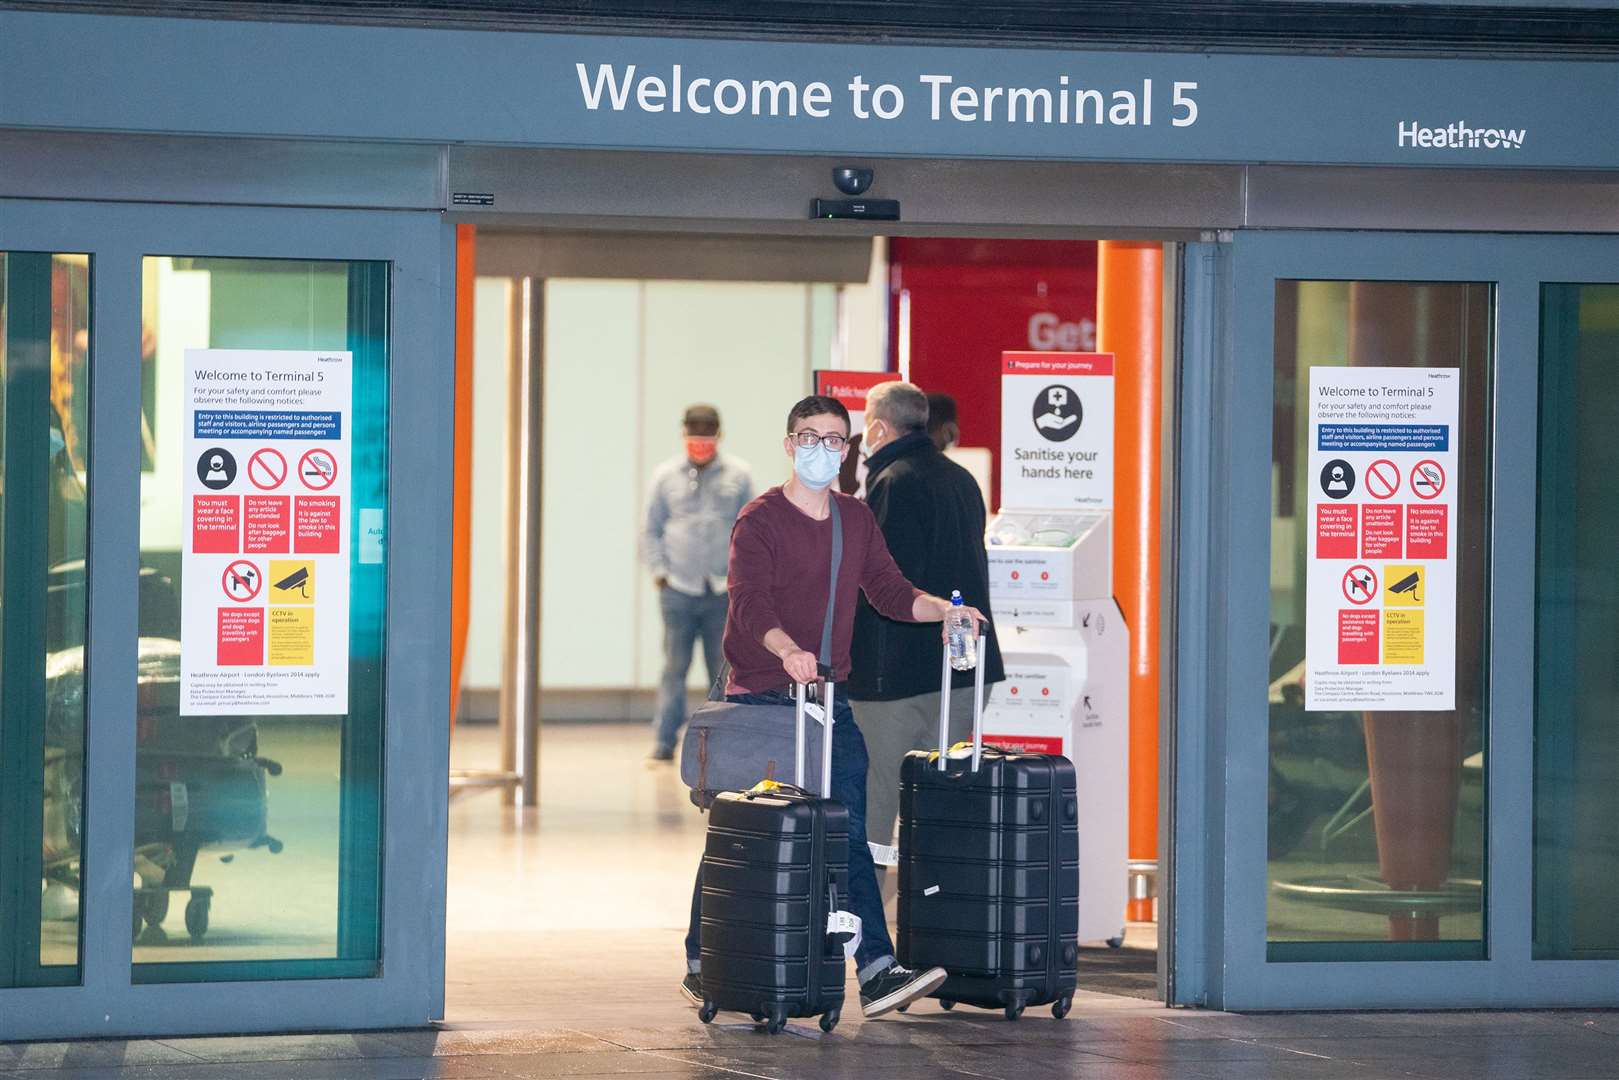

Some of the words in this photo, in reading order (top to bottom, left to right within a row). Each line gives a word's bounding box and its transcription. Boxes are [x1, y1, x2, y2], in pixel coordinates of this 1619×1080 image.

[575, 63, 832, 118] Welcome
[848, 75, 904, 119] to
[920, 74, 1151, 126] Terminal
[1171, 81, 1198, 127] 5
[1399, 120, 1526, 149] Heathrow
[1028, 312, 1096, 351] Get
[1015, 361, 1040, 369] Prepare
[1068, 362, 1093, 370] journey
[195, 370, 247, 380] Welcome
[250, 372, 262, 381] to
[265, 371, 314, 381] Terminal
[317, 372, 324, 382] 5
[226, 388, 249, 396] safety
[1319, 387, 1365, 396] Welcome
[1368, 388, 1379, 396] to
[1381, 387, 1425, 396] Terminal
[1428, 388, 1434, 397] 5
[1347, 403, 1367, 411] safety
[1015, 448, 1064, 461] Sanitise
[1068, 451, 1098, 466] your
[1022, 466, 1060, 478] hands
[1064, 468, 1093, 479] here
